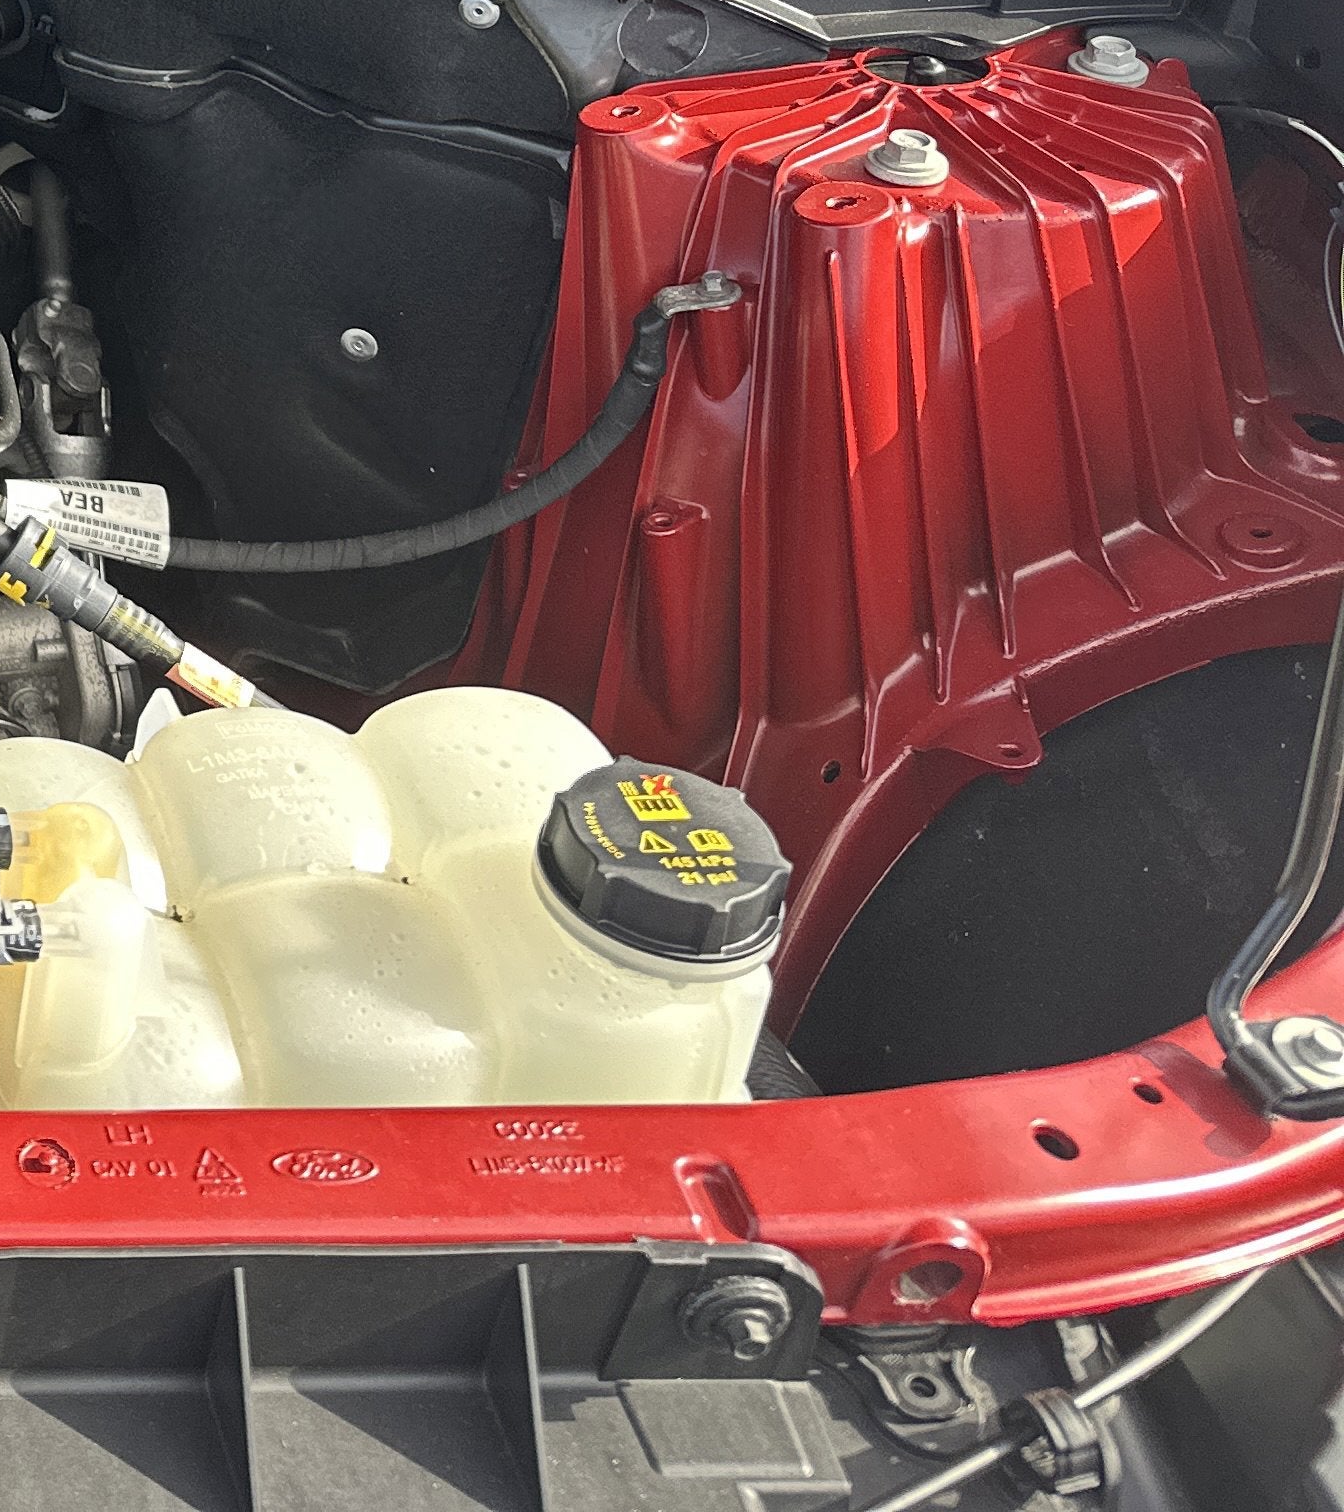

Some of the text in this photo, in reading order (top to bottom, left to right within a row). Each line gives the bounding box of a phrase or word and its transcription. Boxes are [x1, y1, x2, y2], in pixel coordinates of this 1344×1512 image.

[59, 489, 104, 514] BEA
[658, 855, 737, 869] 145 kPa
[677, 871, 705, 885] 21
[104, 1123, 153, 1144] LH
